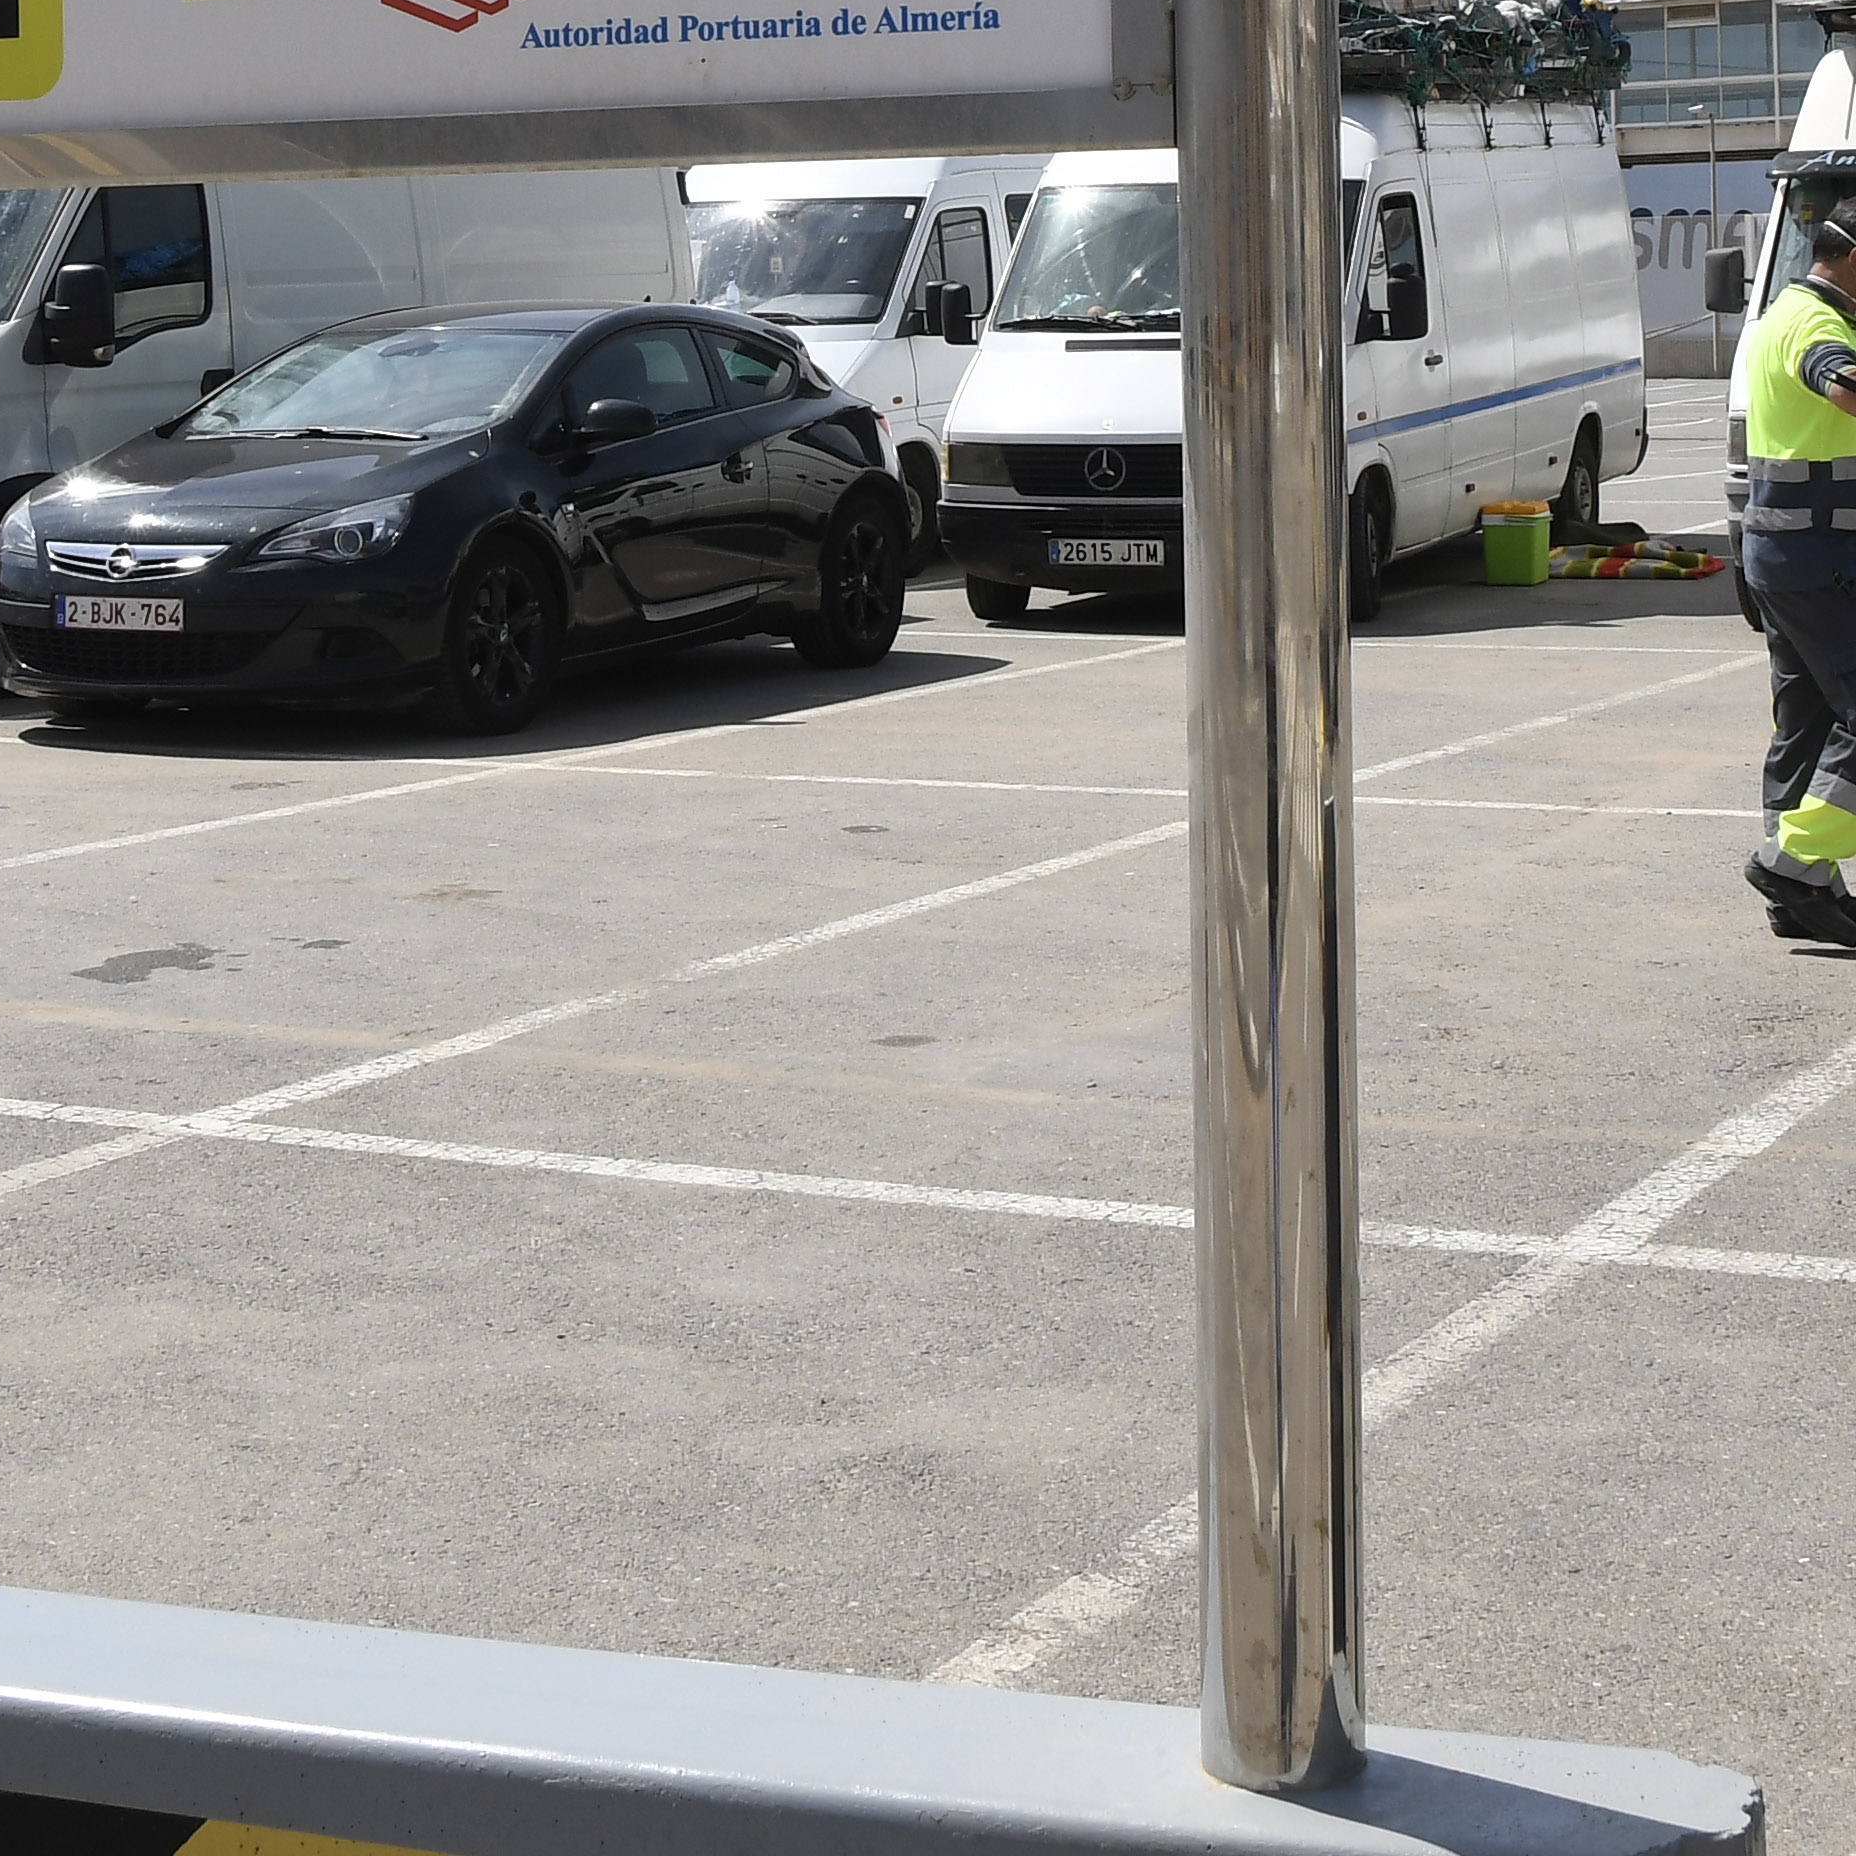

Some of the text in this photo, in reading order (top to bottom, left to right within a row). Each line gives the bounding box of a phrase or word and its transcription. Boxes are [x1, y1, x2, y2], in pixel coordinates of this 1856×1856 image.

[520, 1, 1001, 50] Autoridad Portuaria de Almería
[1063, 542, 1158, 563] 2615 JTM
